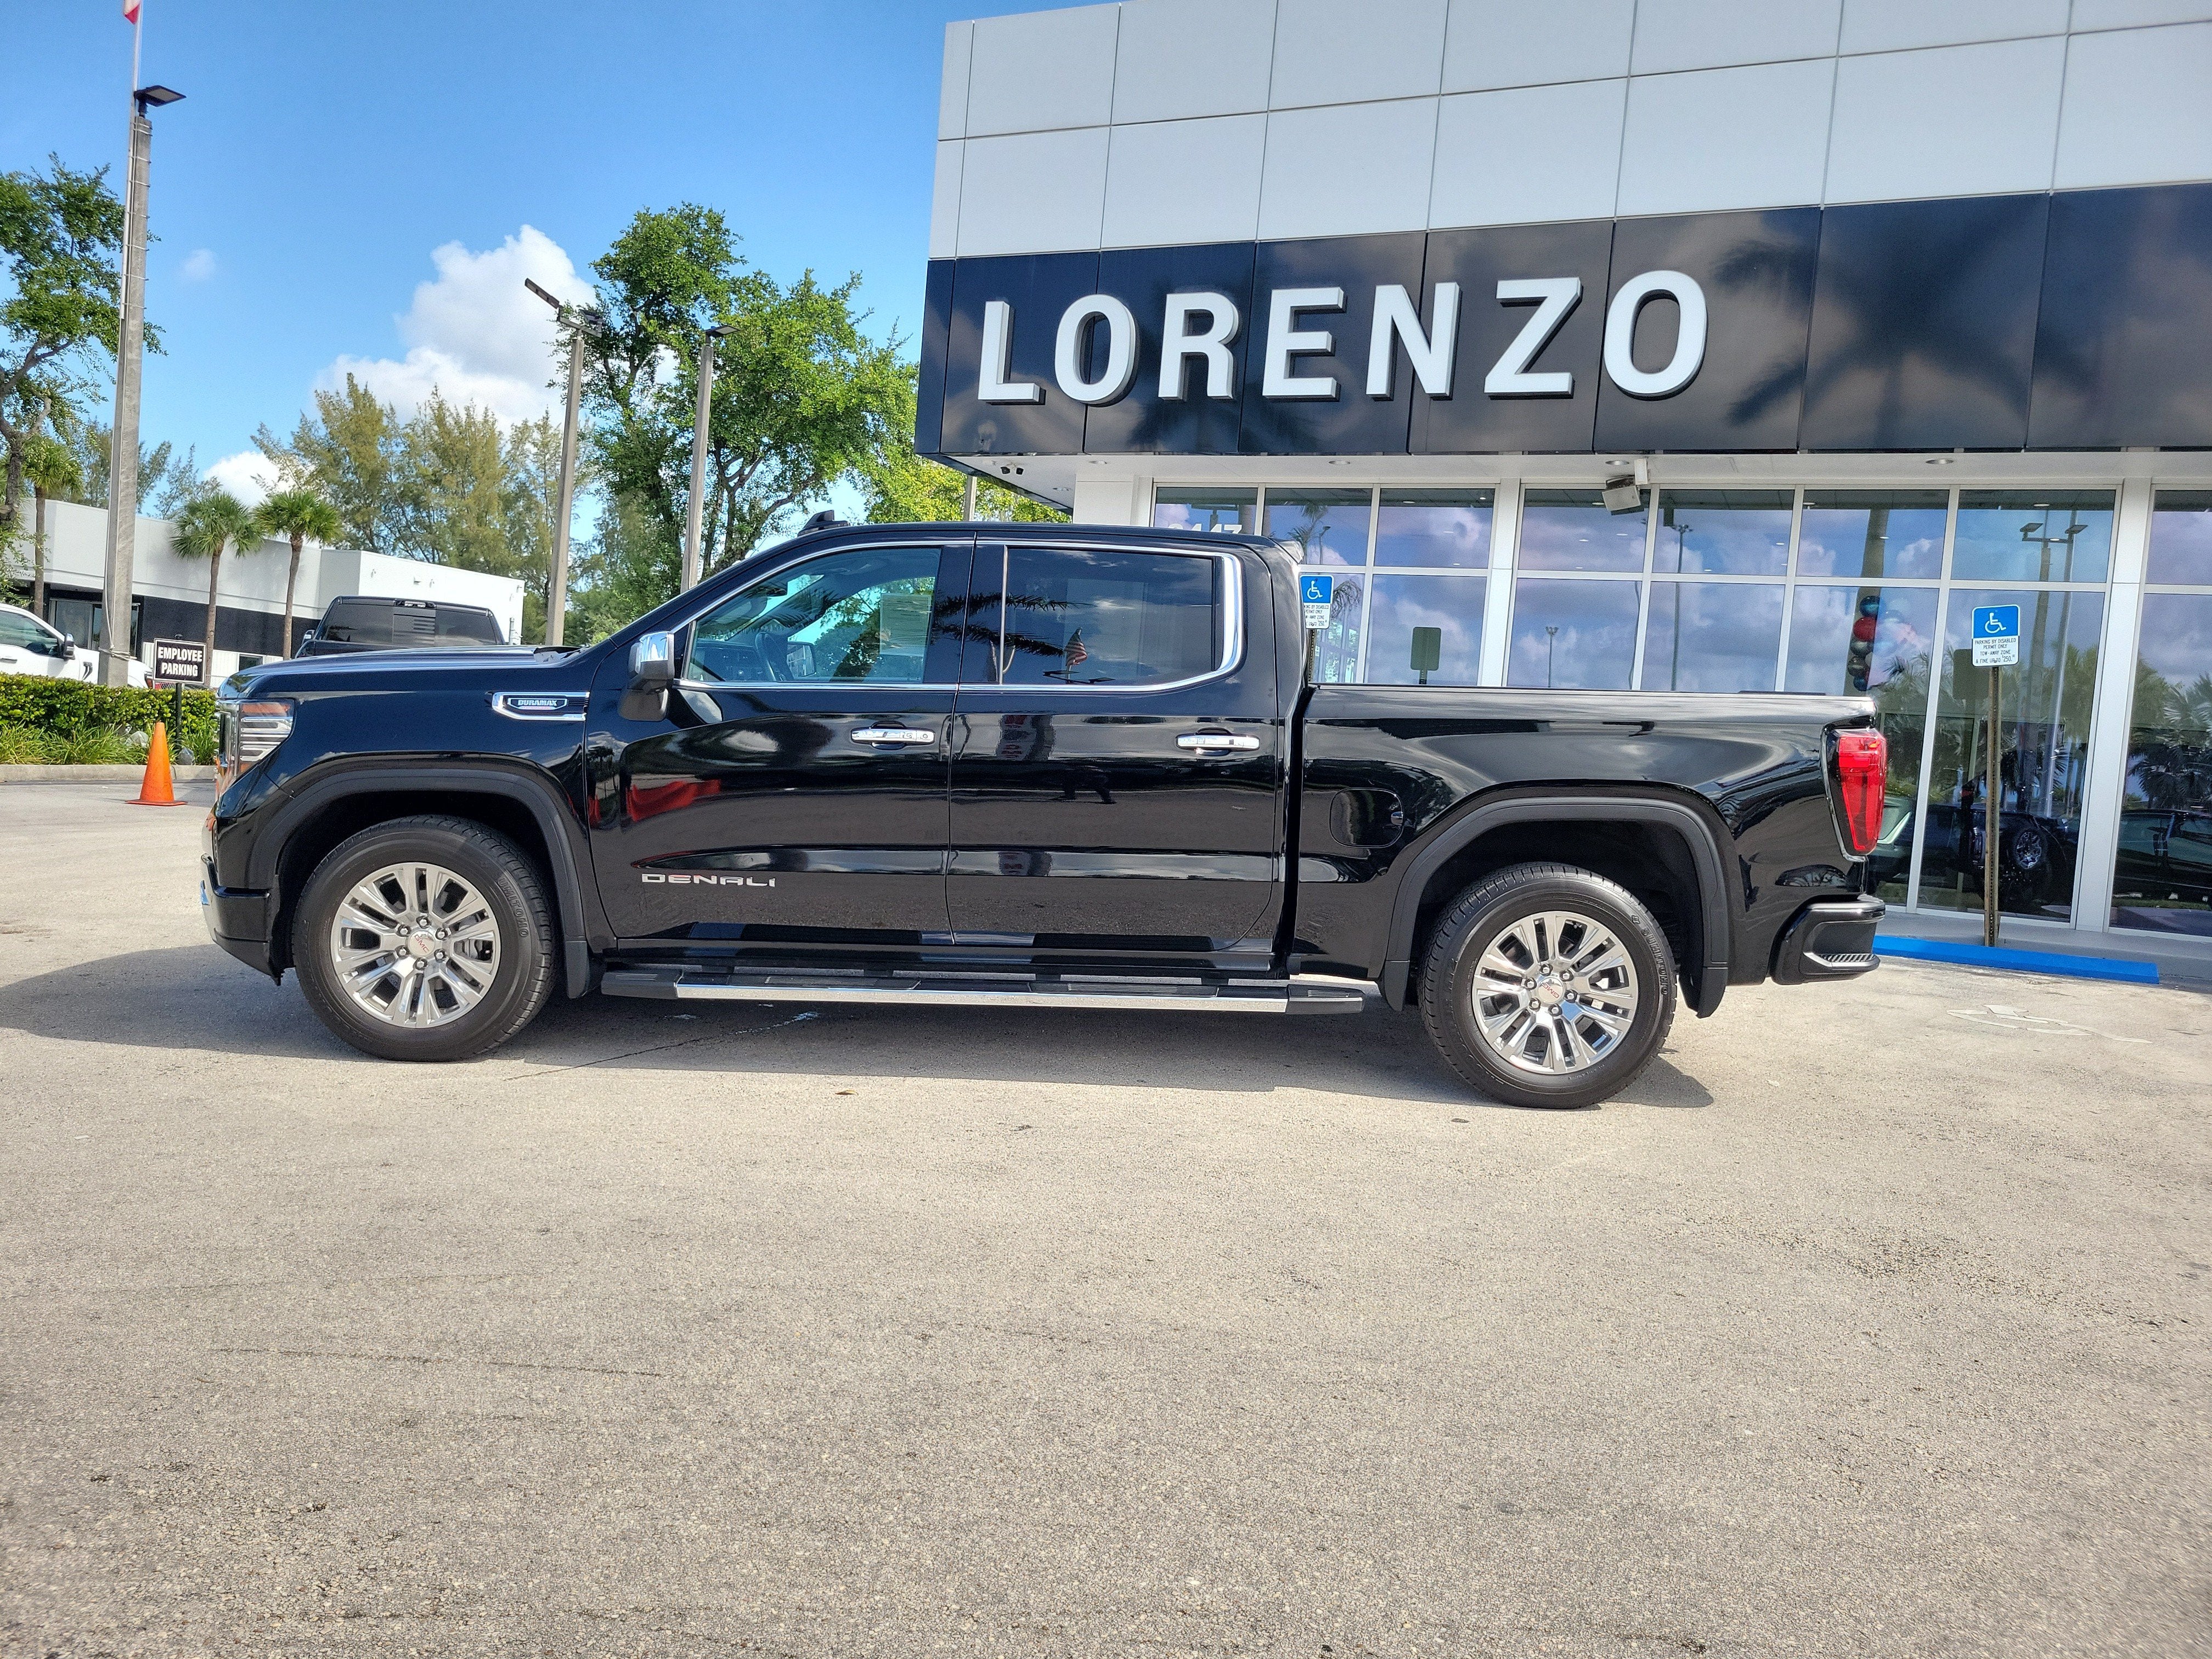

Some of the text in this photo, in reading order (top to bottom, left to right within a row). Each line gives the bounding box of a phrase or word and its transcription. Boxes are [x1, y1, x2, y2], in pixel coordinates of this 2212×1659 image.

[977, 270, 1708, 405] LORENZO
[158, 646, 203, 662] EMPLOYEE
[161, 662, 198, 677] PARKING
[641, 873, 776, 888] DENALI
[414, 934, 430, 953] GMC
[1641, 927, 1668, 995] SUMITOMO
[1542, 982, 1560, 998] GMC
